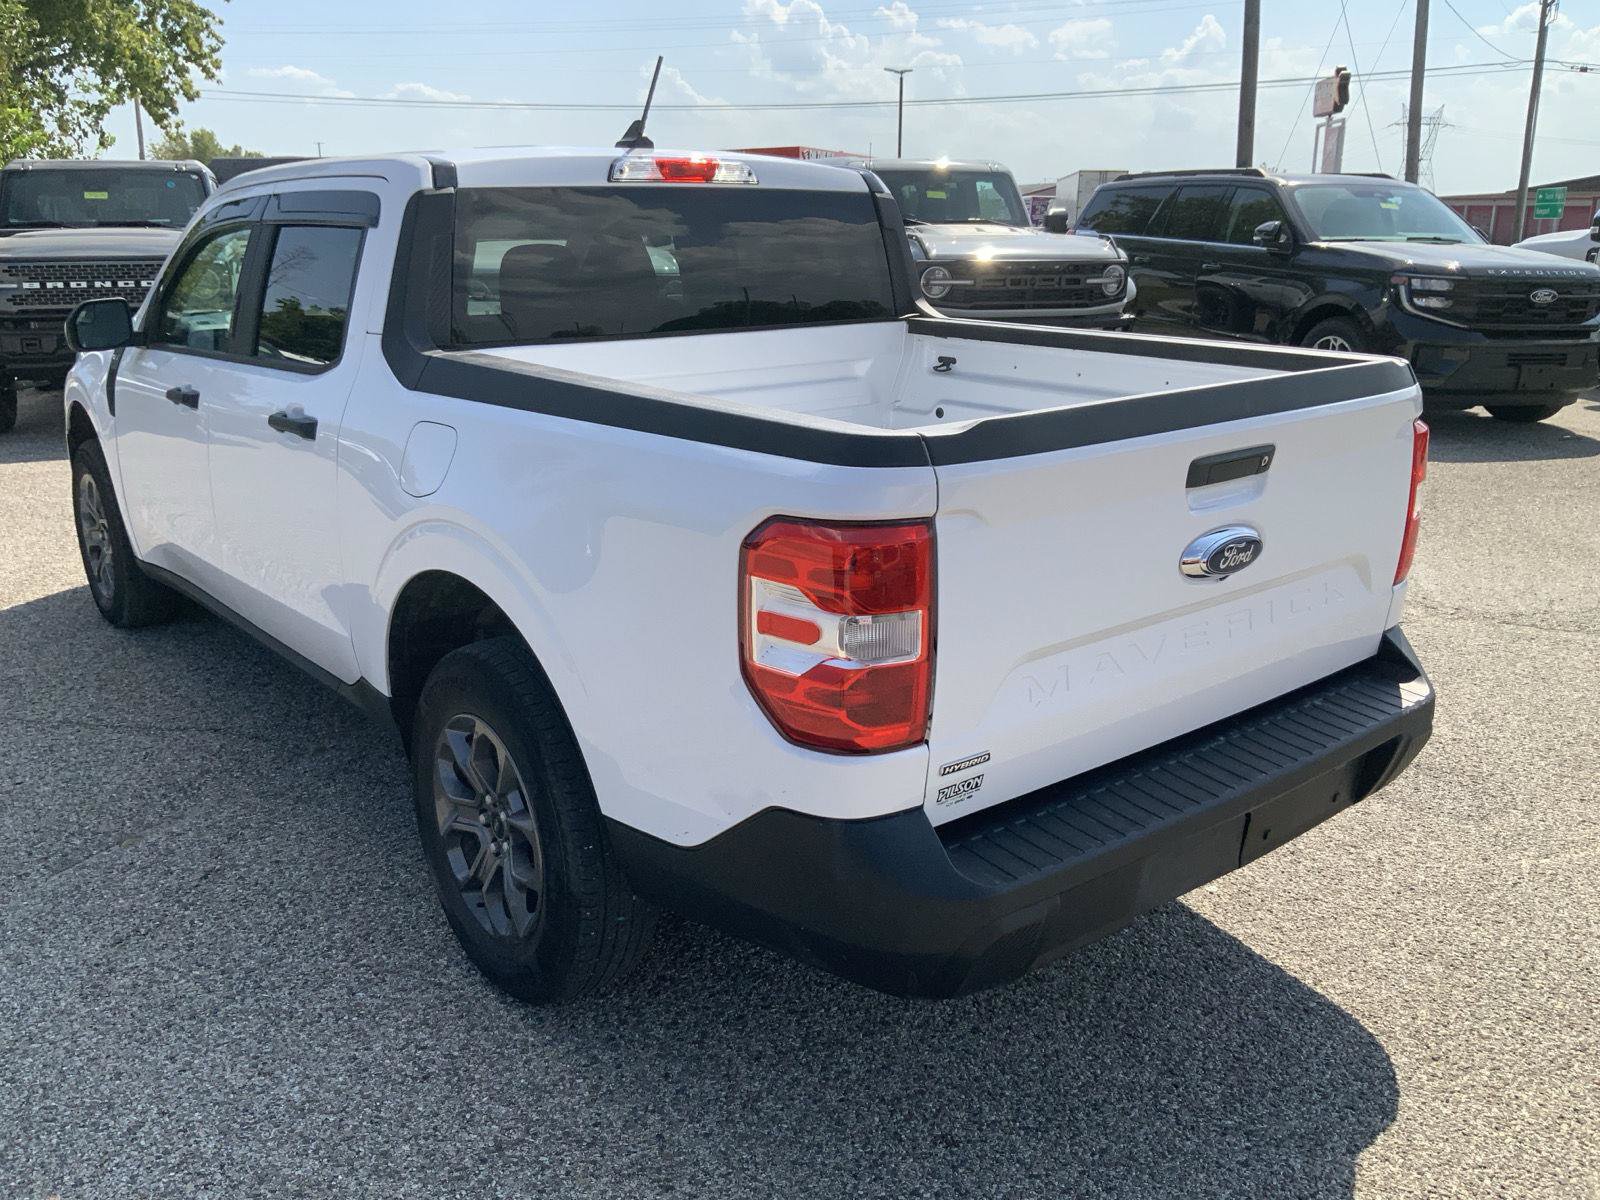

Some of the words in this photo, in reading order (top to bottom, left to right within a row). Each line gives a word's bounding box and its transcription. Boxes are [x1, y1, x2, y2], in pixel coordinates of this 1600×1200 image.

[22, 280, 156, 289] BRONCO
[1534, 291, 1554, 302] Ford
[1220, 541, 1255, 570] Ford
[1022, 579, 1347, 707] MAVERICK
[944, 754, 990, 774] HYBRID
[937, 774, 984, 803] PILSON
